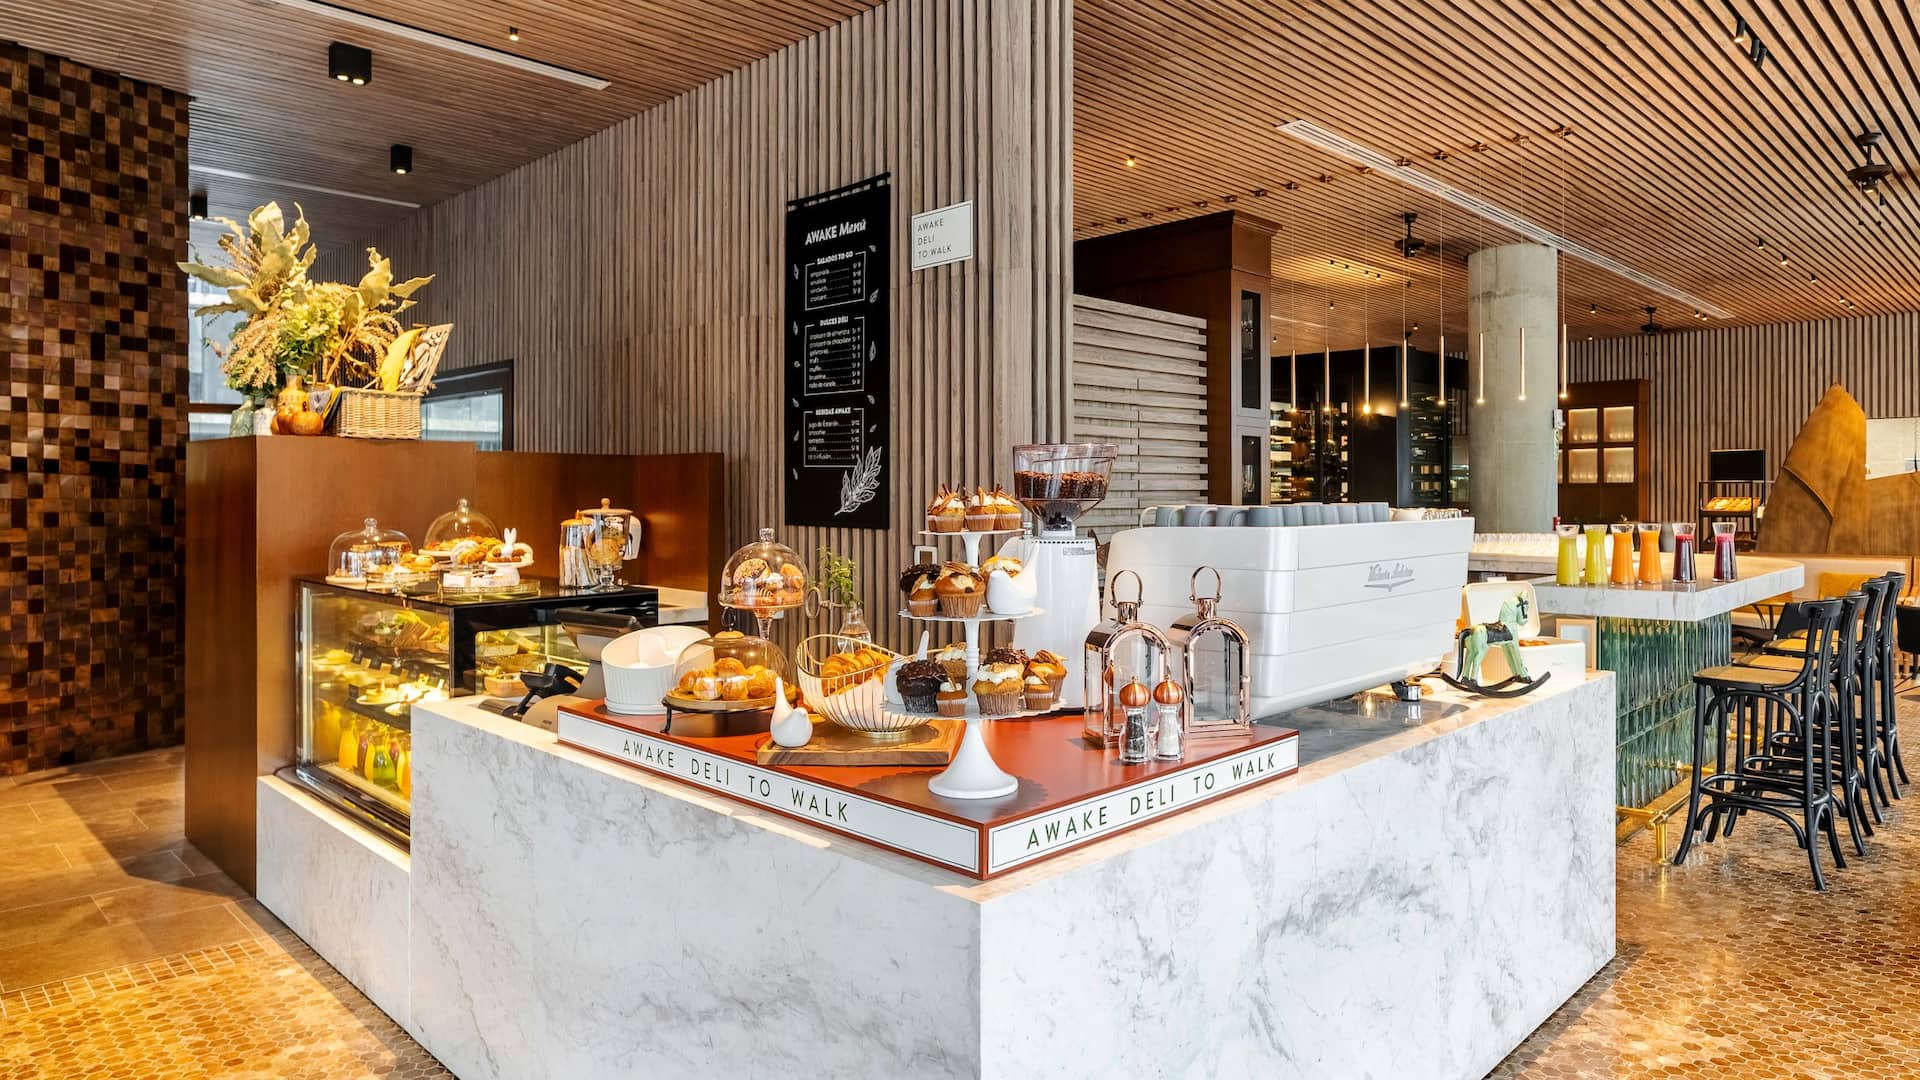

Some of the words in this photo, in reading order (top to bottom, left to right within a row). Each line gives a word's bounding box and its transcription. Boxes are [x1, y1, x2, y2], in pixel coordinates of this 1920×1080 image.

[917, 218, 944, 232] AWAKE
[805, 225, 837, 246] AWAKE
[917, 233, 935, 246] DELI
[918, 250, 928, 259] TO
[930, 244, 952, 256] WALK
[623, 739, 674, 768] AWAKE
[691, 758, 729, 786] DELI
[748, 775, 771, 797] TO
[791, 787, 848, 822] WALK
[1027, 806, 1108, 849] AWAKE
[1130, 784, 1174, 816] DELI
[1193, 772, 1215, 794] TO
[1232, 752, 1275, 781] WALK
